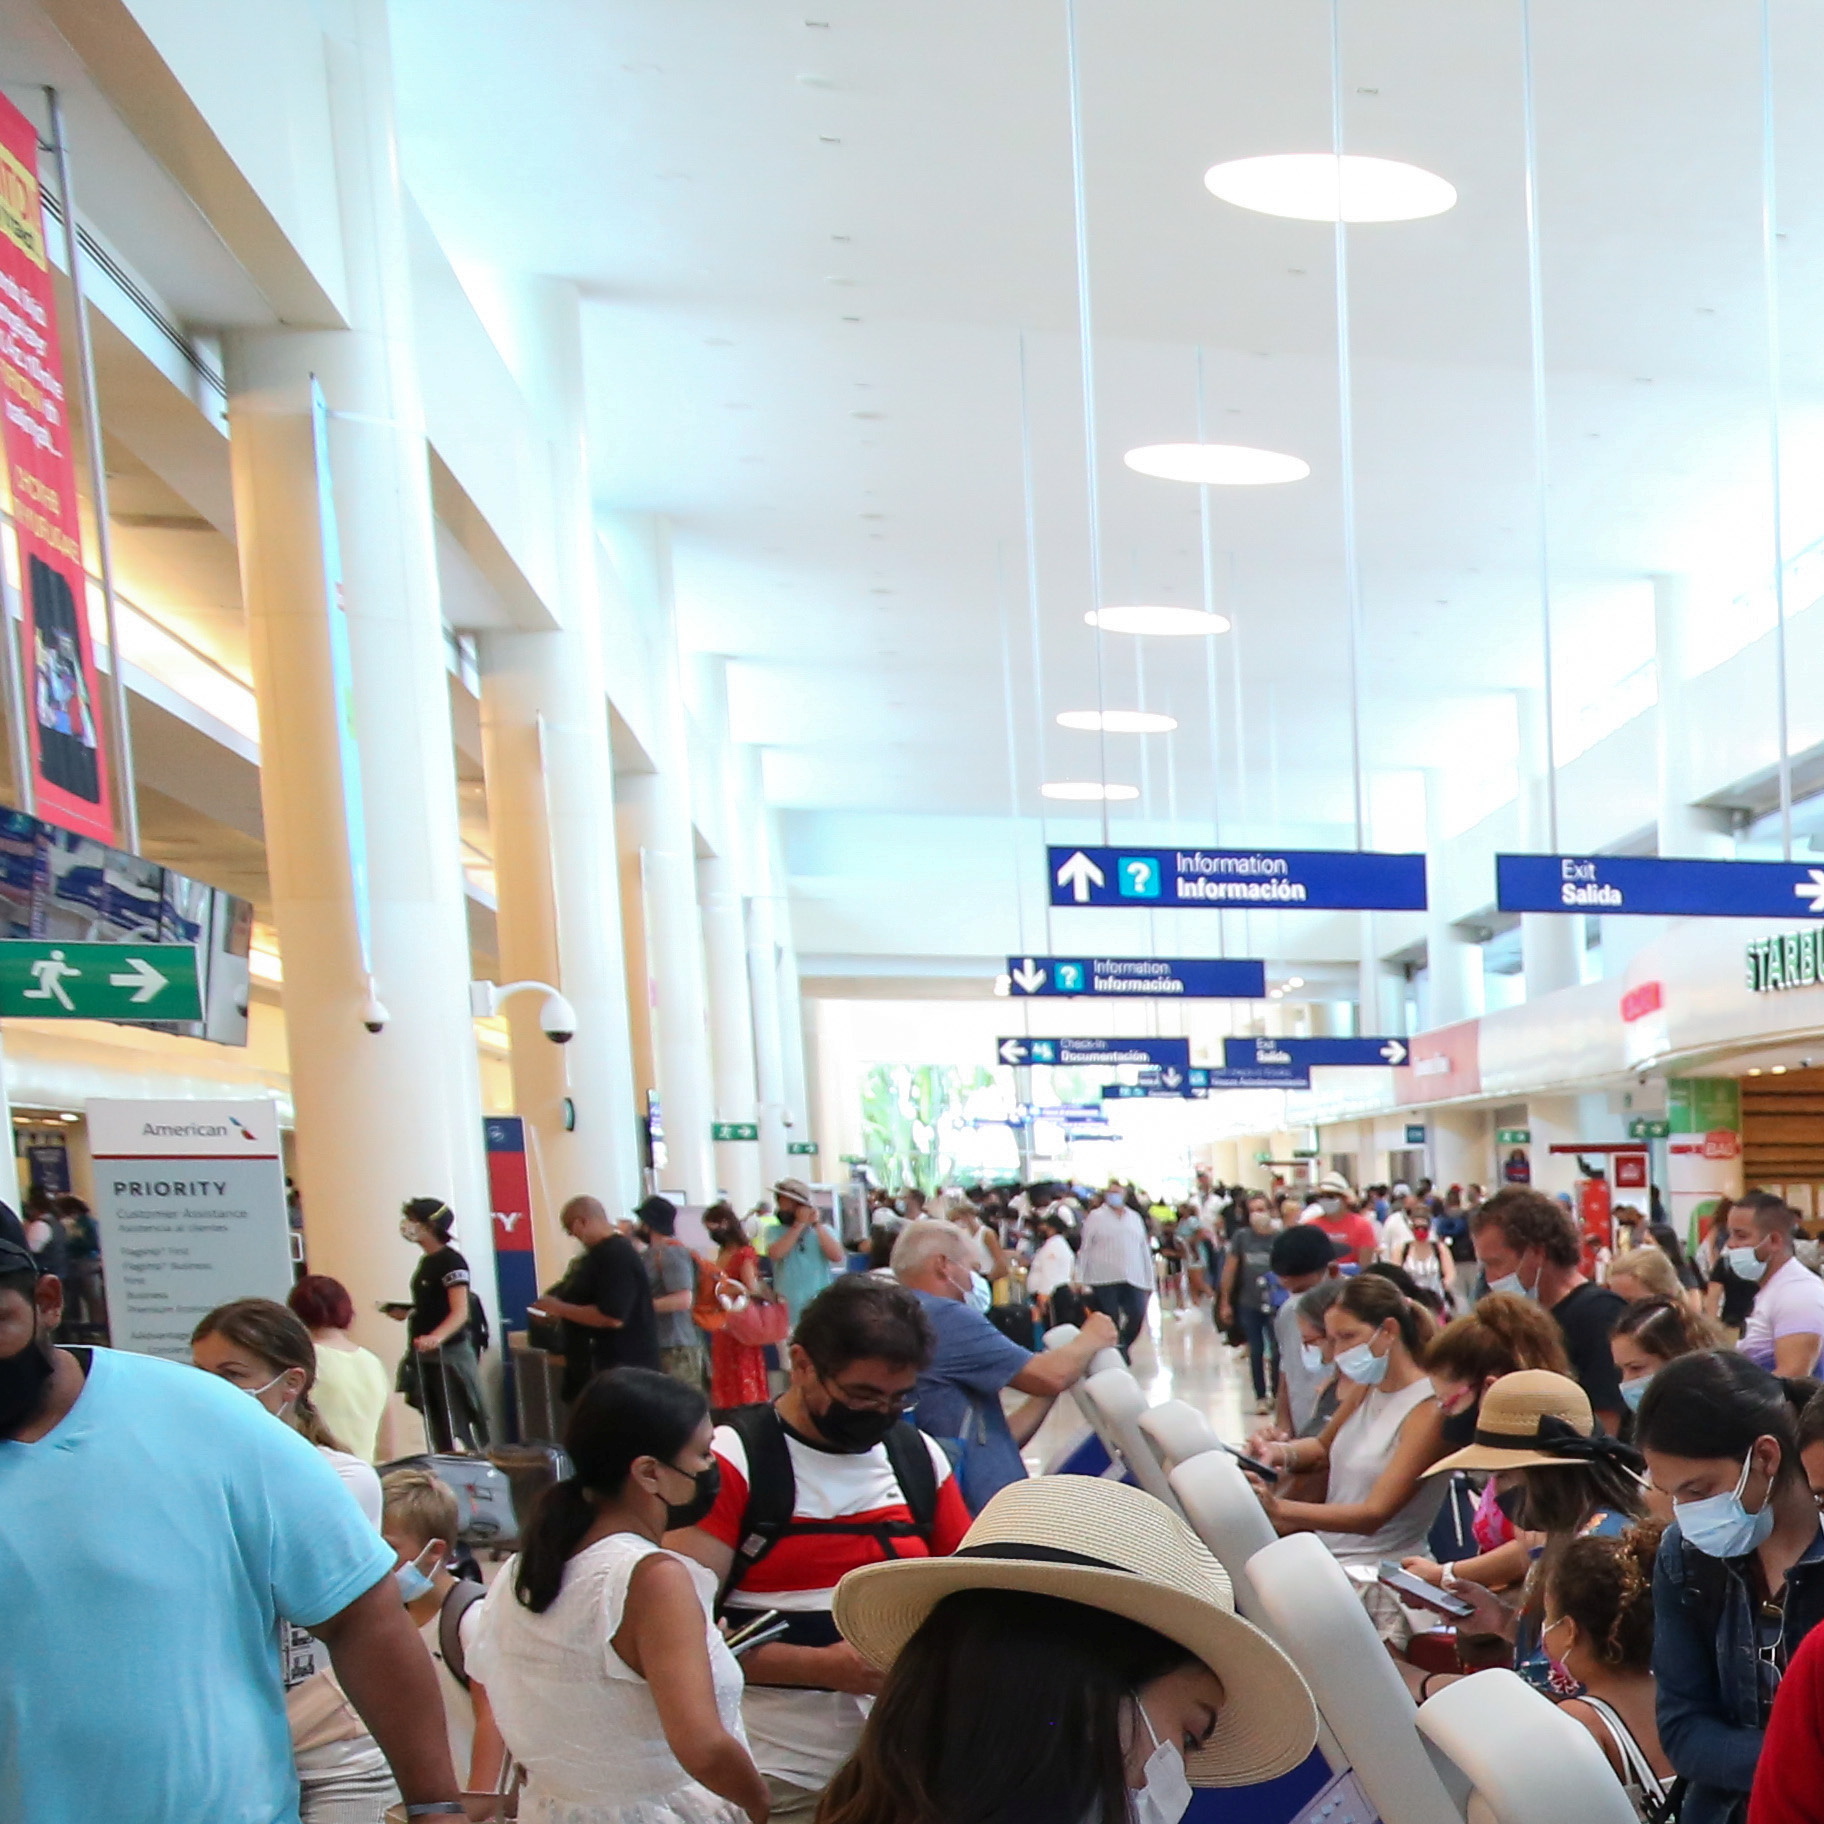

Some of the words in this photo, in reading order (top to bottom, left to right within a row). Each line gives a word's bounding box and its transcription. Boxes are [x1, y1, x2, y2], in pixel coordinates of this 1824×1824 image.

[1176, 852, 1289, 877] Information
[1561, 858, 1597, 881] Exit
[1176, 877, 1307, 903] Información
[1561, 883, 1623, 907] Salida
[1094, 960, 1172, 976] Information
[1094, 976, 1185, 994] Información
[1060, 1049, 1151, 1063] Documentación
[1256, 1050, 1292, 1063] Salida
[142, 1122, 228, 1137] American
[113, 1181, 227, 1198] PRIORITY
